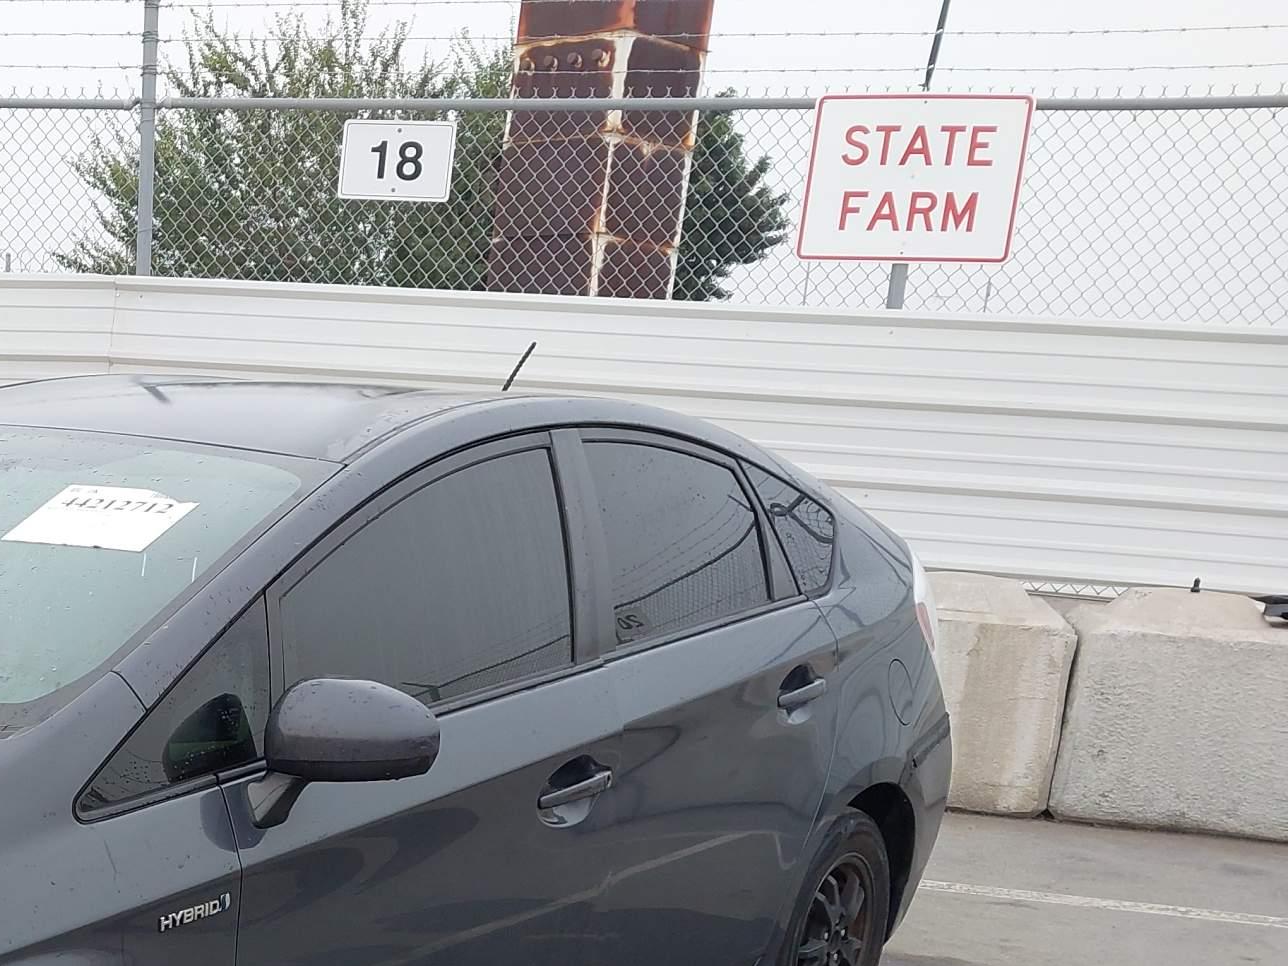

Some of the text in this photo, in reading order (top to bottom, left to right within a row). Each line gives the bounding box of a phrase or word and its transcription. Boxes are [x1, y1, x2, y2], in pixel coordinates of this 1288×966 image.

[371, 140, 423, 181] 18
[841, 125, 997, 167] STATE
[838, 191, 979, 232] FARM
[61, 497, 175, 514] 44212712
[160, 899, 222, 932] HYBRID
